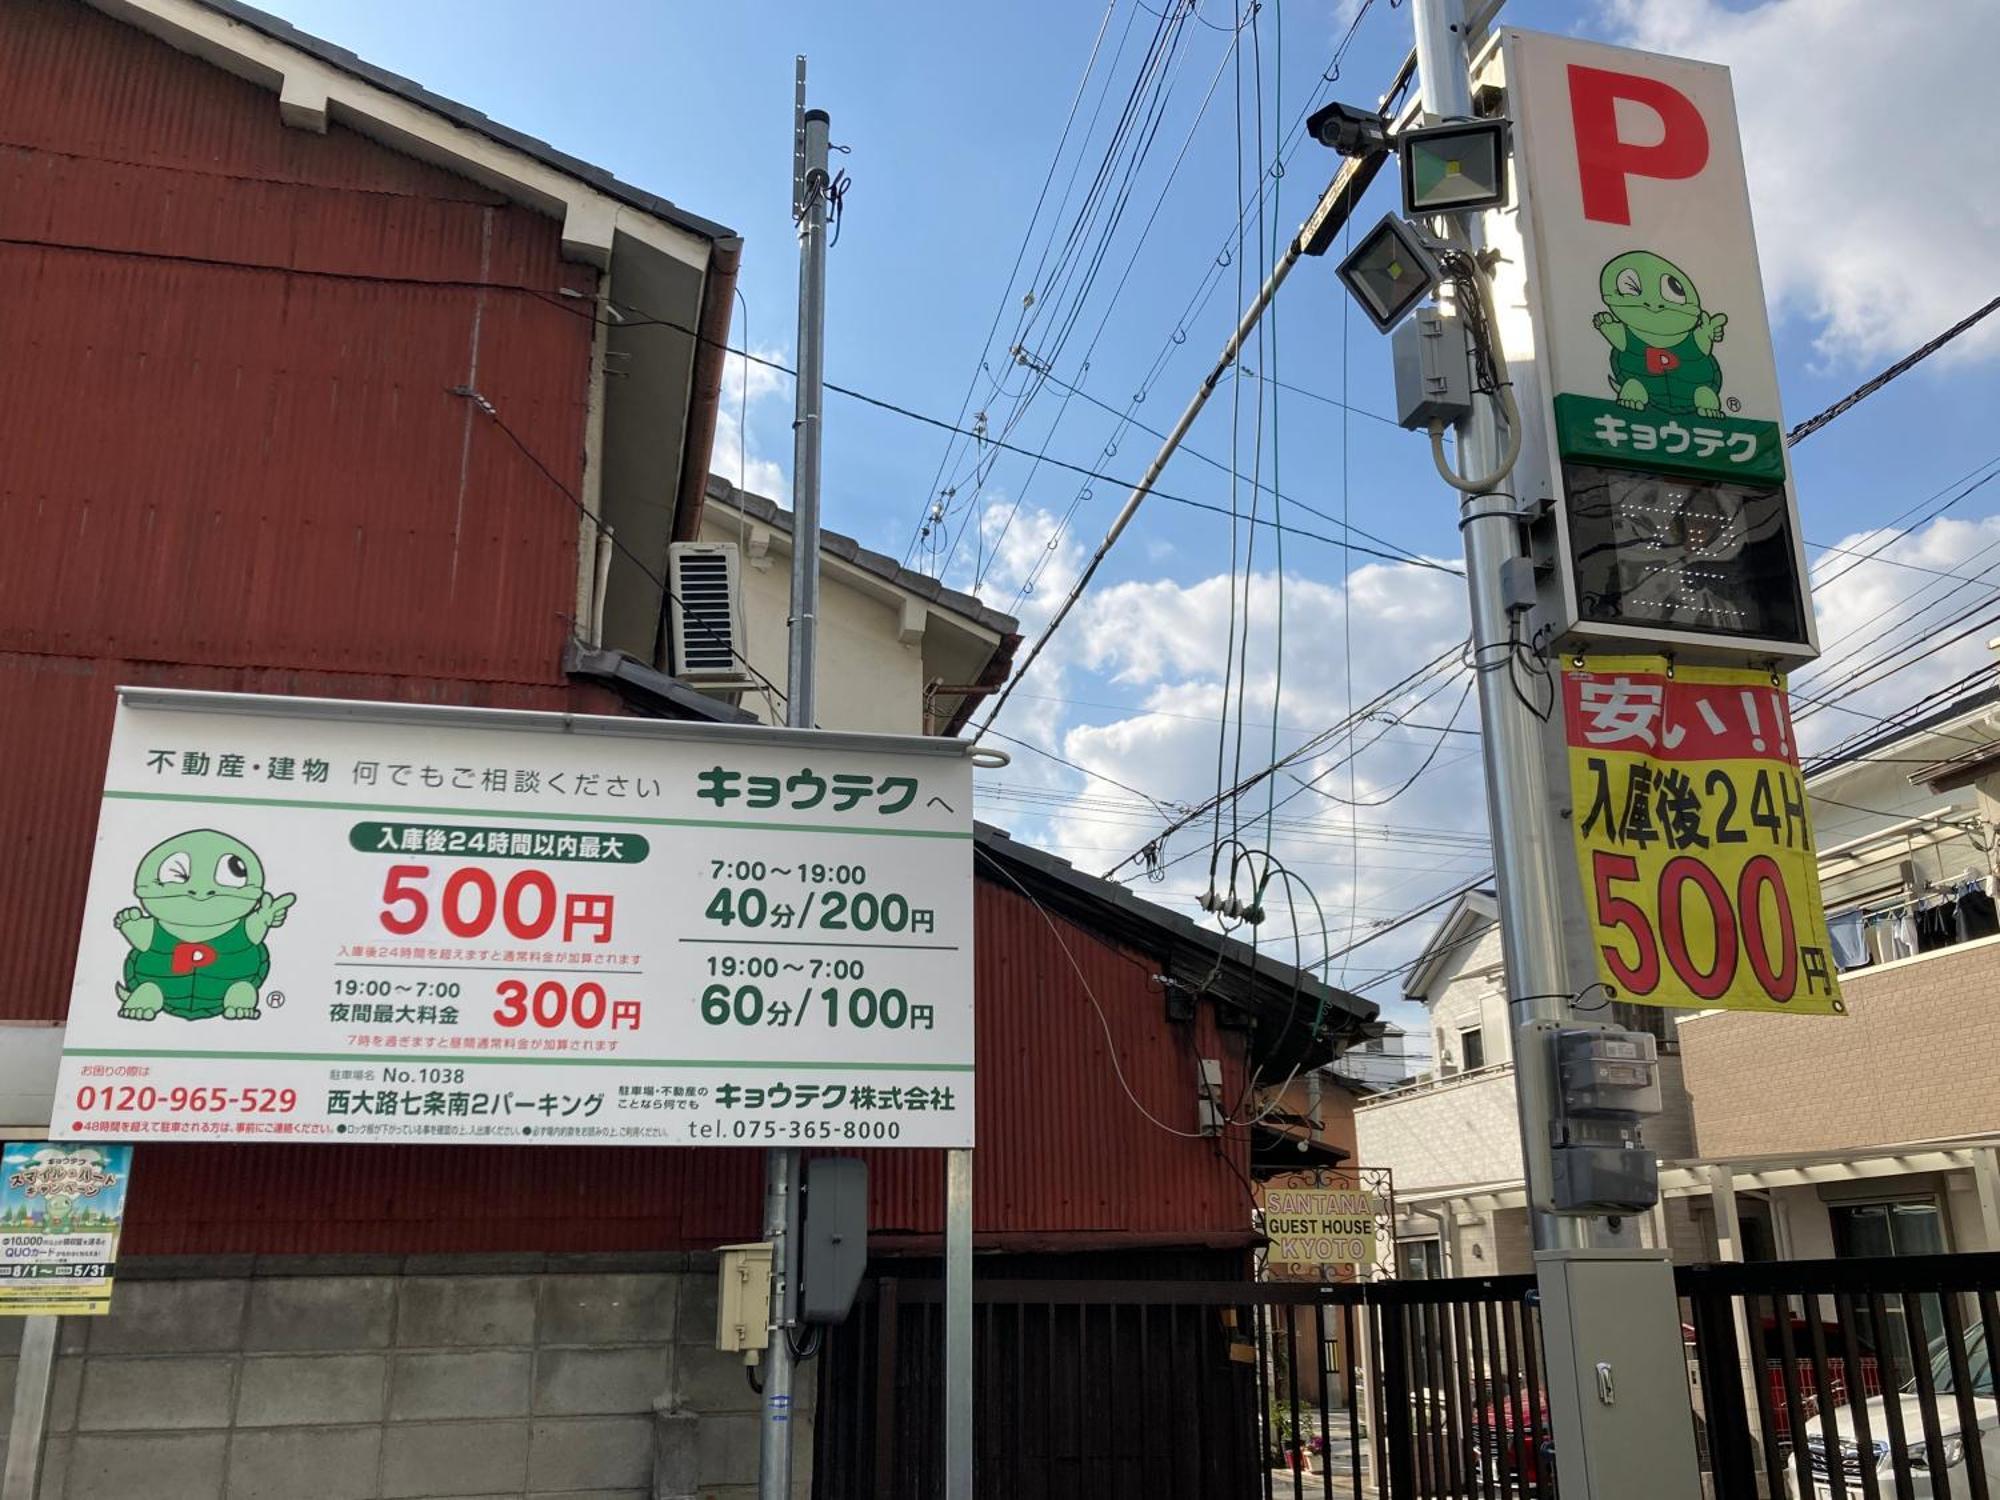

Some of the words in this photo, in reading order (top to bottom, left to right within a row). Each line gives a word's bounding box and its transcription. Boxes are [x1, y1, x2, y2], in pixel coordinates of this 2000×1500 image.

[1567, 63, 1710, 227] P
[1594, 413, 1757, 463] キョウテク
[146, 749, 330, 784] 不動産・建物
[352, 760, 661, 799] 何でもご相談ください
[1580, 756, 1811, 852] 入庫後24H
[376, 826, 625, 861] 入庫後24時間以内最大
[379, 865, 614, 944] 500円
[704, 887, 934, 934] 40分/200円
[1592, 848, 1833, 1004] 500円
[329, 1003, 460, 1026] 夜間最大料金
[493, 979, 642, 1031] 300円
[701, 984, 934, 1030] 60分/100円
[80, 1065, 151, 1078] お困りの際は
[330, 1068, 375, 1082] 駐車場名
[383, 1067, 465, 1084] No.1038
[76, 1085, 297, 1113] 0120-965-529
[327, 1089, 605, 1118] 西大路七条南2パーキング
[617, 1098, 700, 1111] ことなら何でも
[715, 1081, 956, 1112] キョウテク株式会社
[1268, 1193, 1372, 1216] SANTANA
[1269, 1219, 1318, 1235] GUEST
[1322, 1220, 1372, 1235] HOUSE
[1281, 1237, 1366, 1260] KYOTO
